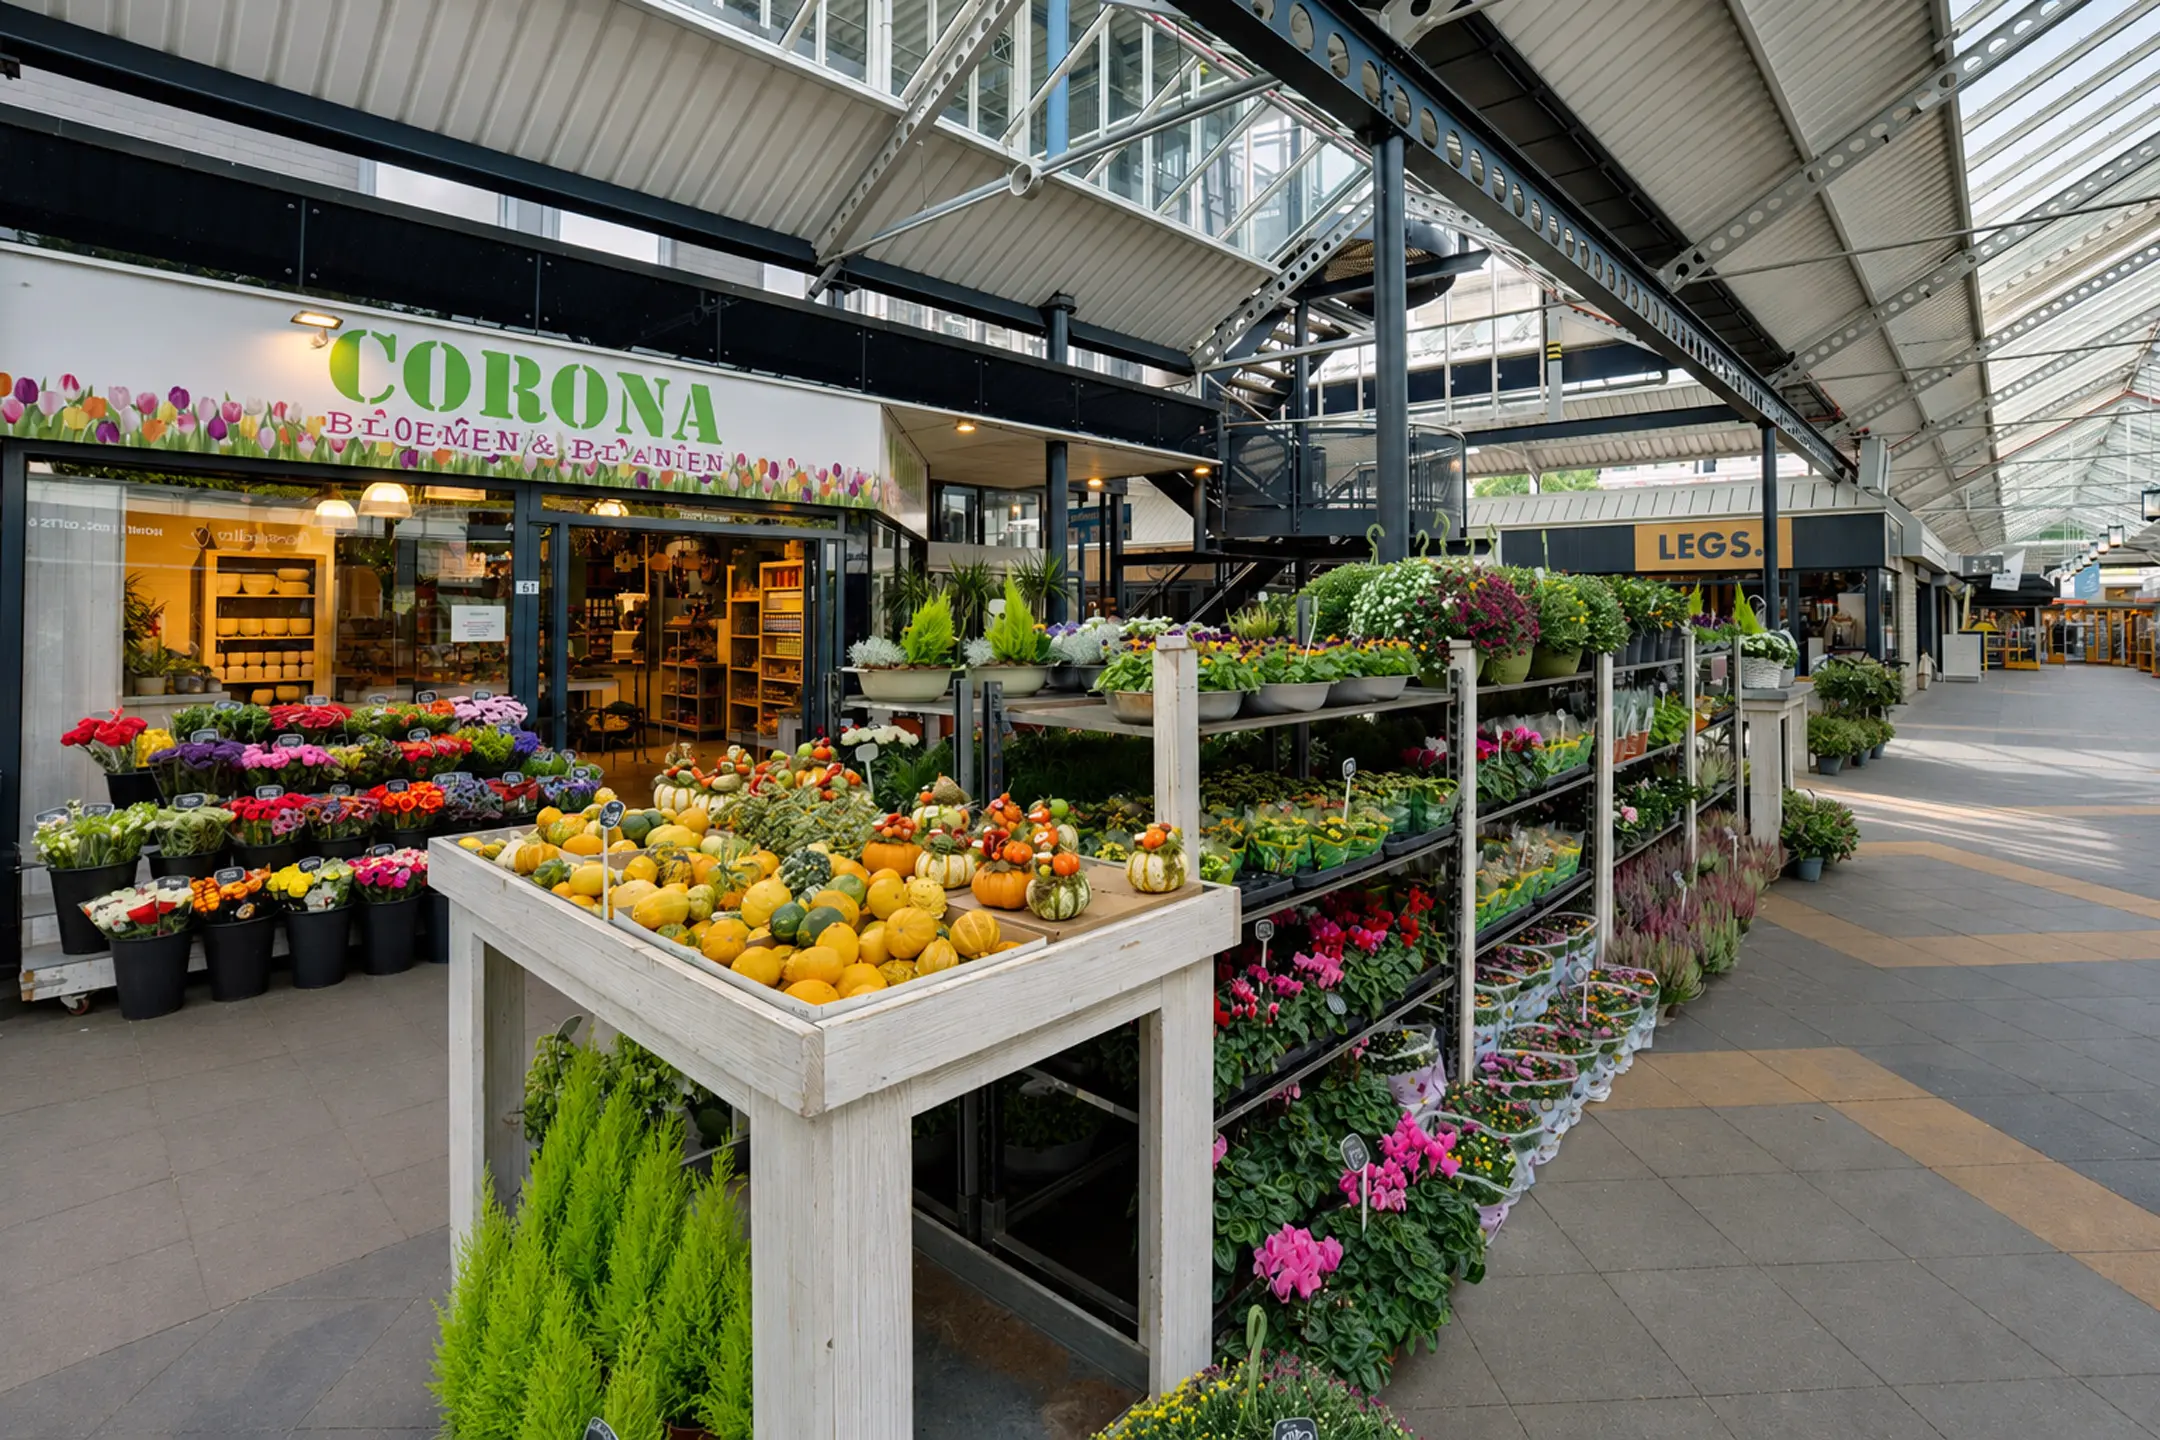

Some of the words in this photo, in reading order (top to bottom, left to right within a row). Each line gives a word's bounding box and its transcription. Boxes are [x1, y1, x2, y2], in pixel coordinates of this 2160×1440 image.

[329, 329, 723, 445] CORONA
[326, 410, 520, 452] BLOEMEN
[531, 434, 555, 456] &
[1658, 530, 1763, 561] LEGS.
